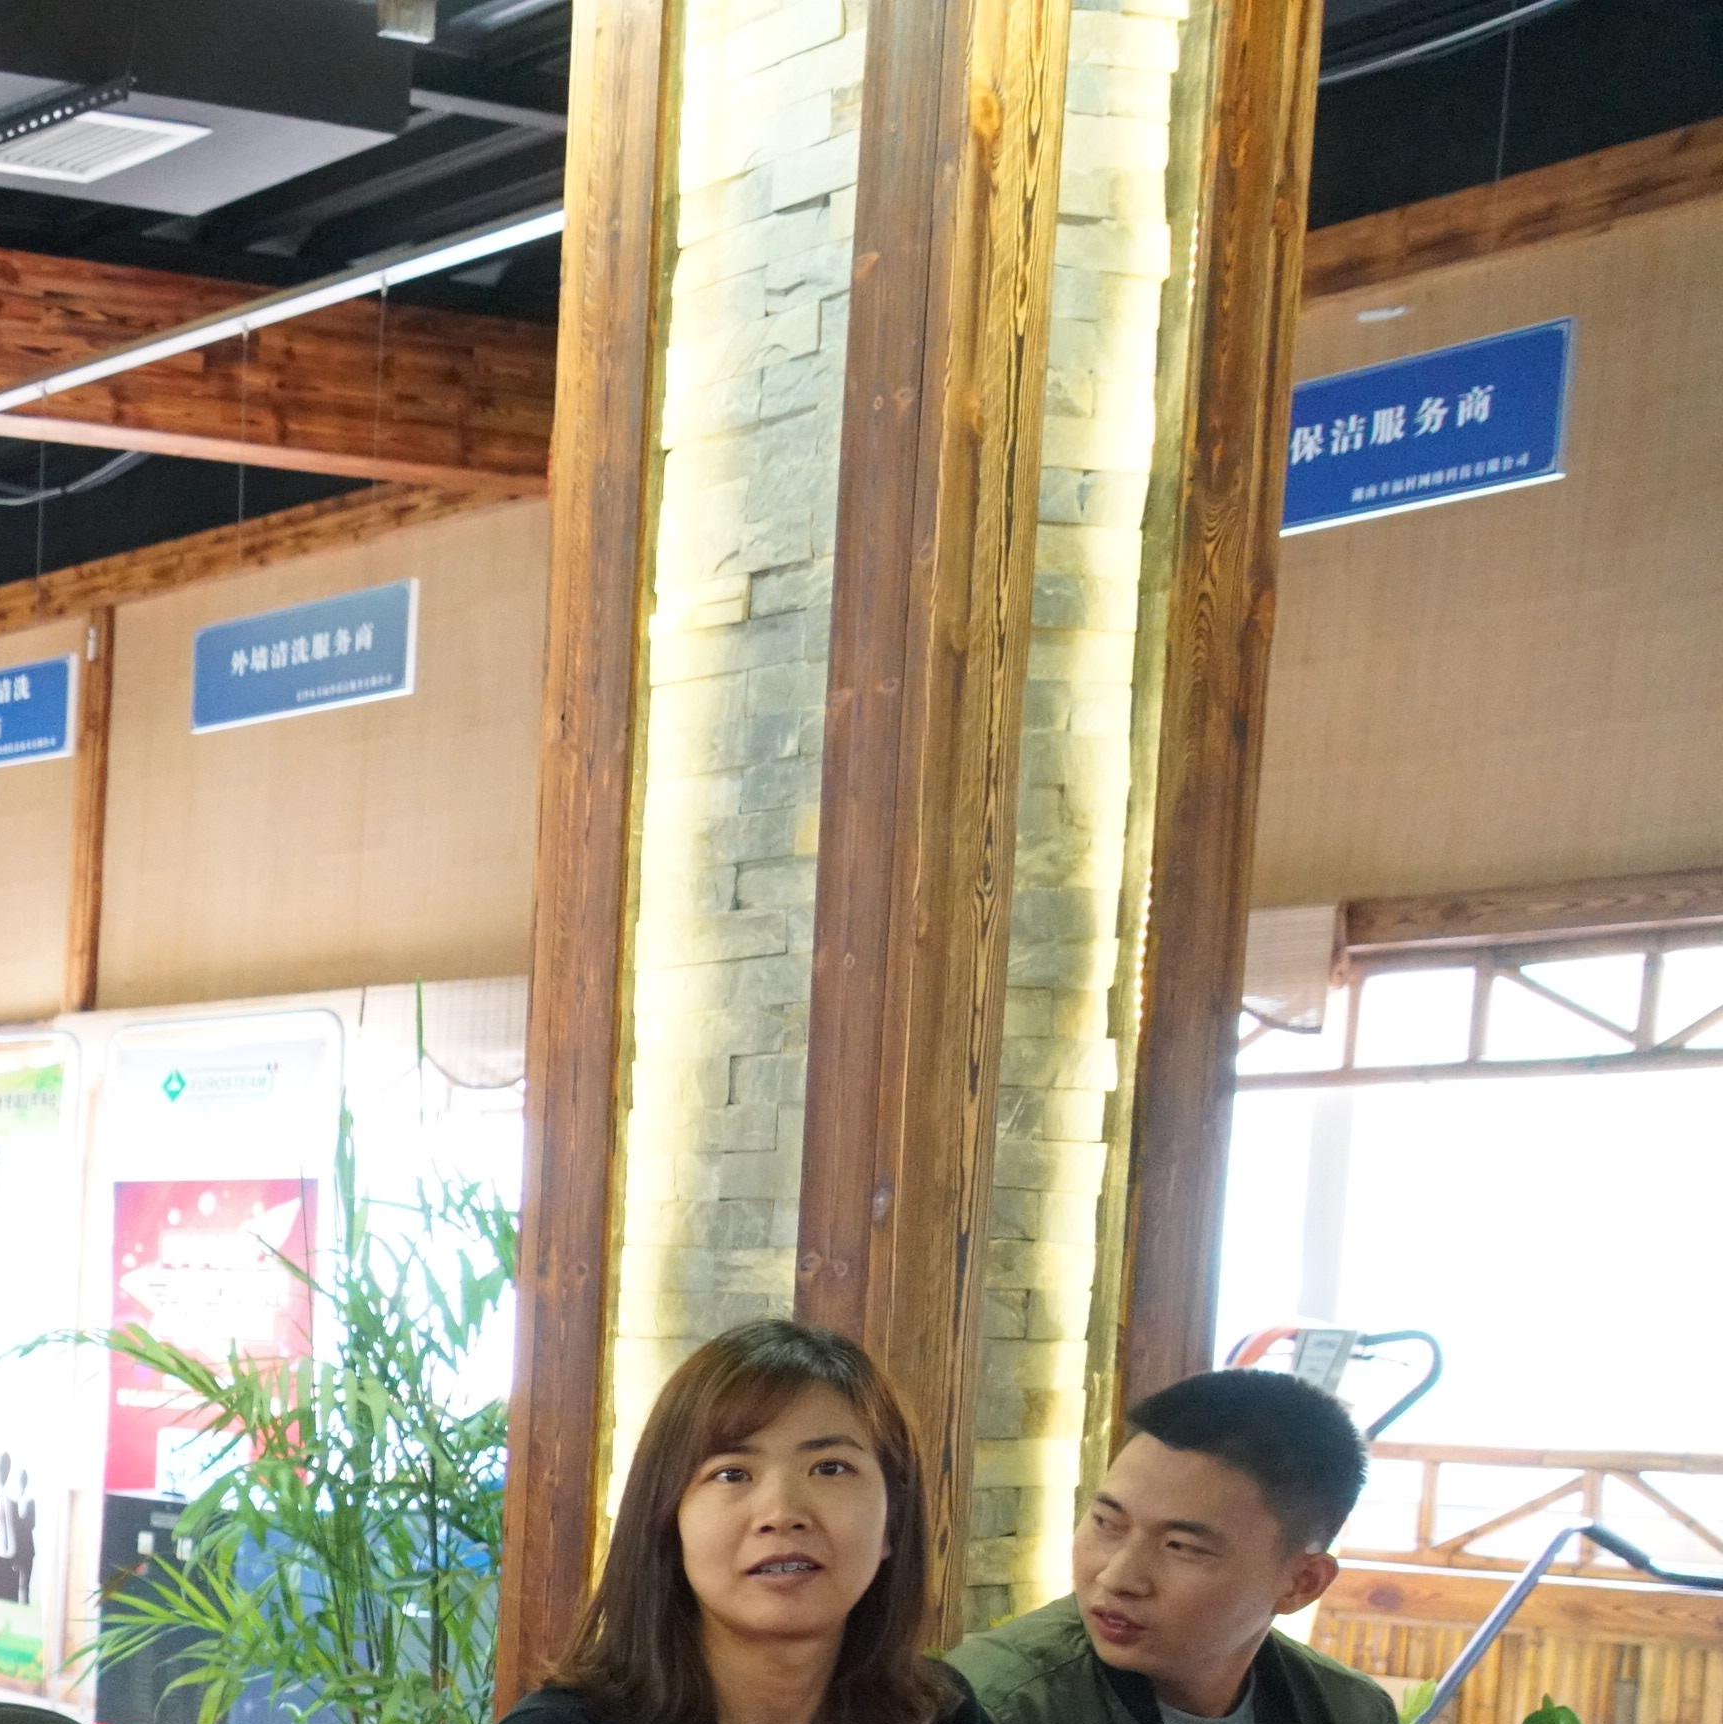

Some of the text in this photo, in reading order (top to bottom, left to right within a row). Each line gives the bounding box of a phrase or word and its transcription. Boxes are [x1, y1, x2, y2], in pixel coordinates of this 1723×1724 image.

[1289, 384, 1495, 466] 保洁服务商
[230, 621, 375, 678] 外墙清洗服务商
